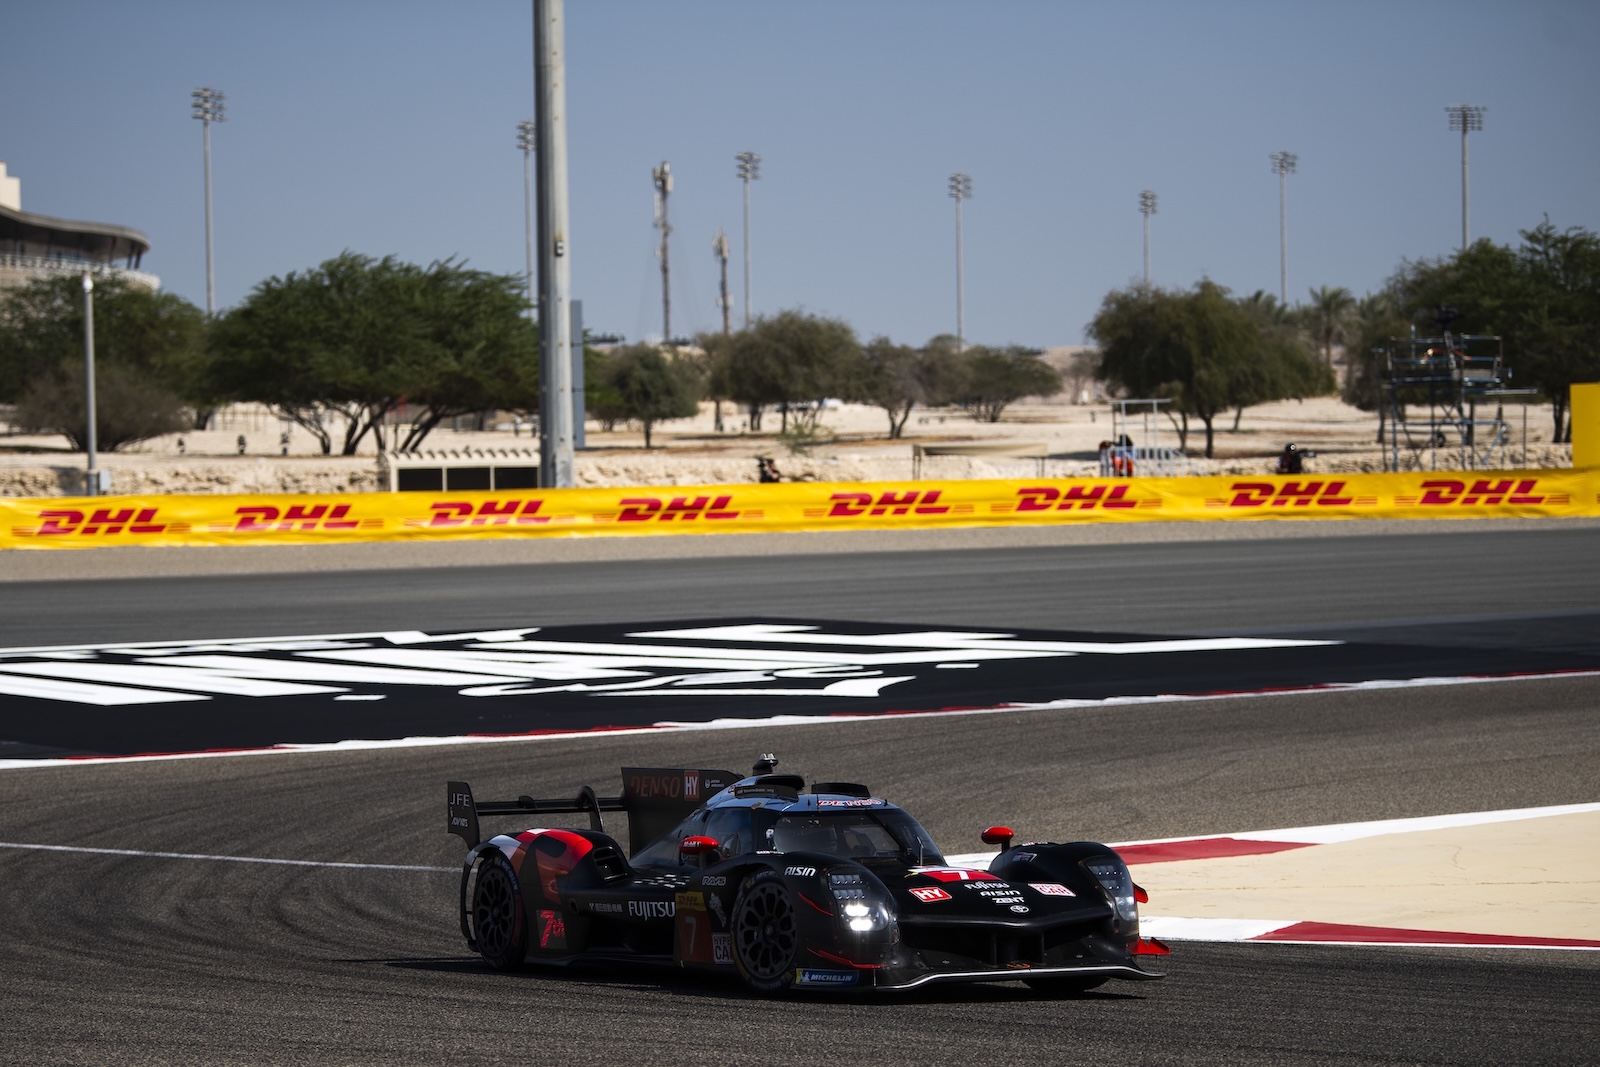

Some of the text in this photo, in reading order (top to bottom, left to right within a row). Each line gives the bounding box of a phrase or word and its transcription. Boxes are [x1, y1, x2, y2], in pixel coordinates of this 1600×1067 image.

[1015, 485, 1139, 512] DHL
[1228, 481, 1355, 508] DHL
[1419, 479, 1547, 505] DHL
[428, 499, 553, 528] DHL
[617, 495, 742, 523] DHL
[828, 491, 951, 517] DHL
[37, 507, 168, 536] DHL
[234, 504, 361, 533] DHL
[629, 775, 681, 799] DENSO
[685, 776, 698, 796] HY
[449, 793, 470, 807] JFE
[818, 799, 881, 807] DENSO
[701, 875, 727, 887] RAYS
[783, 865, 816, 878] AISIN
[941, 870, 970, 880] 7
[914, 888, 945, 900] HY
[963, 881, 1010, 890] FUJITSU
[627, 900, 676, 921] FUJITSU
[685, 916, 696, 955] 7
[713, 936, 731, 946] HYPE
[715, 945, 734, 960] CA
[810, 974, 853, 982] MICHELIN
